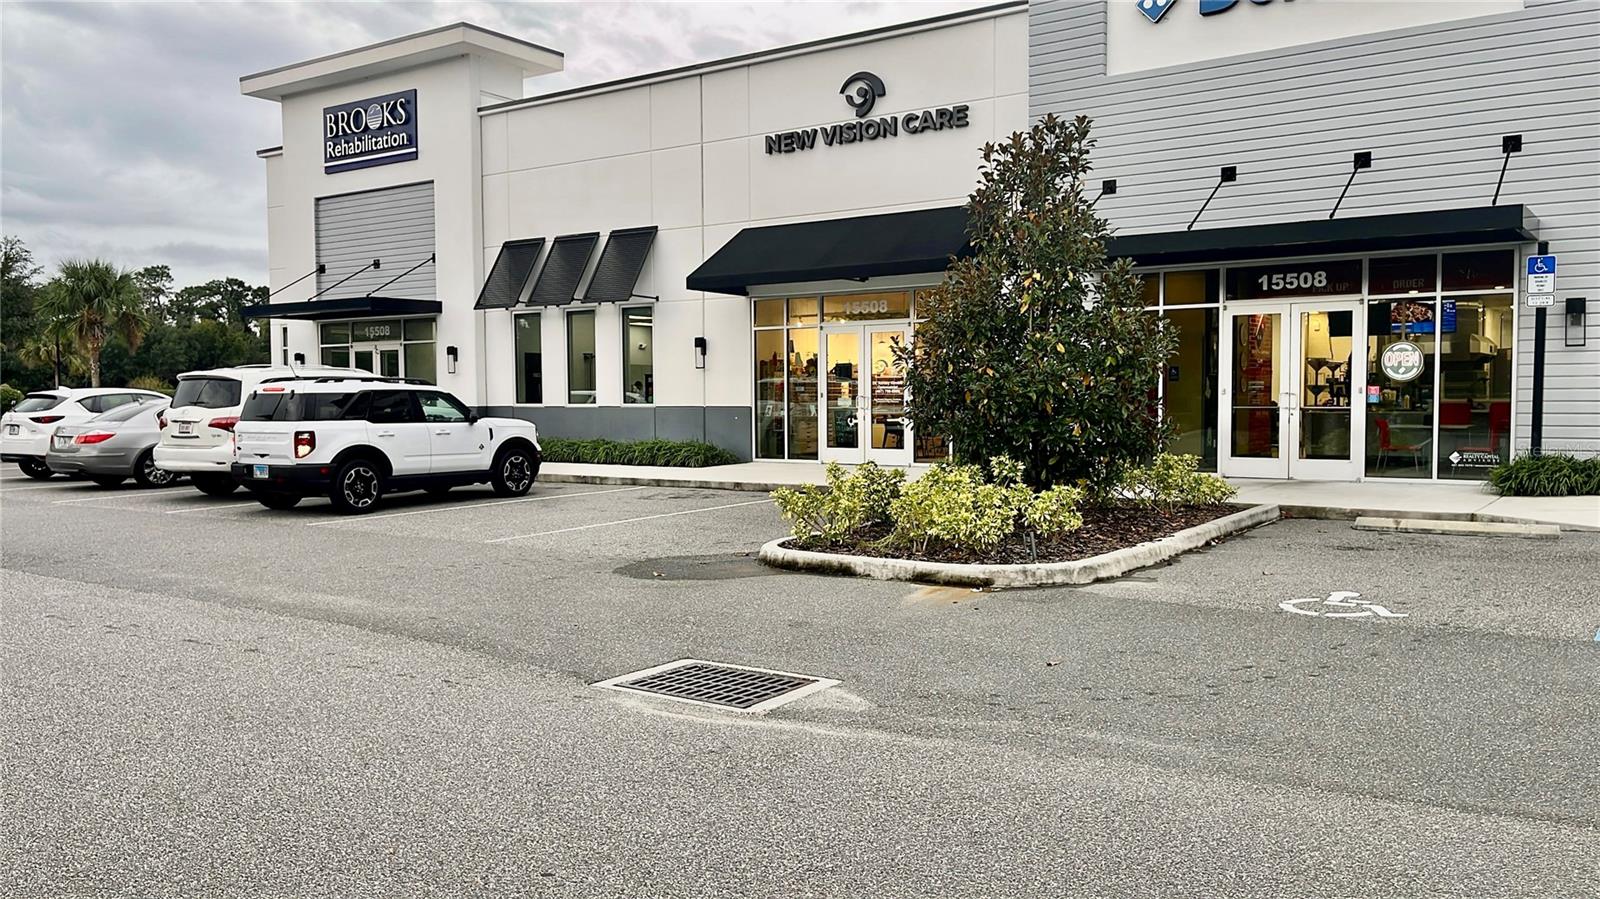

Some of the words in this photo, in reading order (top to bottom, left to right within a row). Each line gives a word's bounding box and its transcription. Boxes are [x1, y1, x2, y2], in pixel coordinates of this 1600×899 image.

[326, 98, 406, 138] BROOKS
[765, 128, 818, 155] NEW
[820, 116, 898, 146] VISION
[901, 104, 970, 134] CARE
[326, 131, 406, 158] Rehabilitation
[1258, 271, 1328, 291] 15508
[1392, 278, 1425, 289] ORDER
[844, 300, 888, 314] 15508
[364, 325, 390, 337] 15508
[1384, 351, 1420, 367] OPEN
